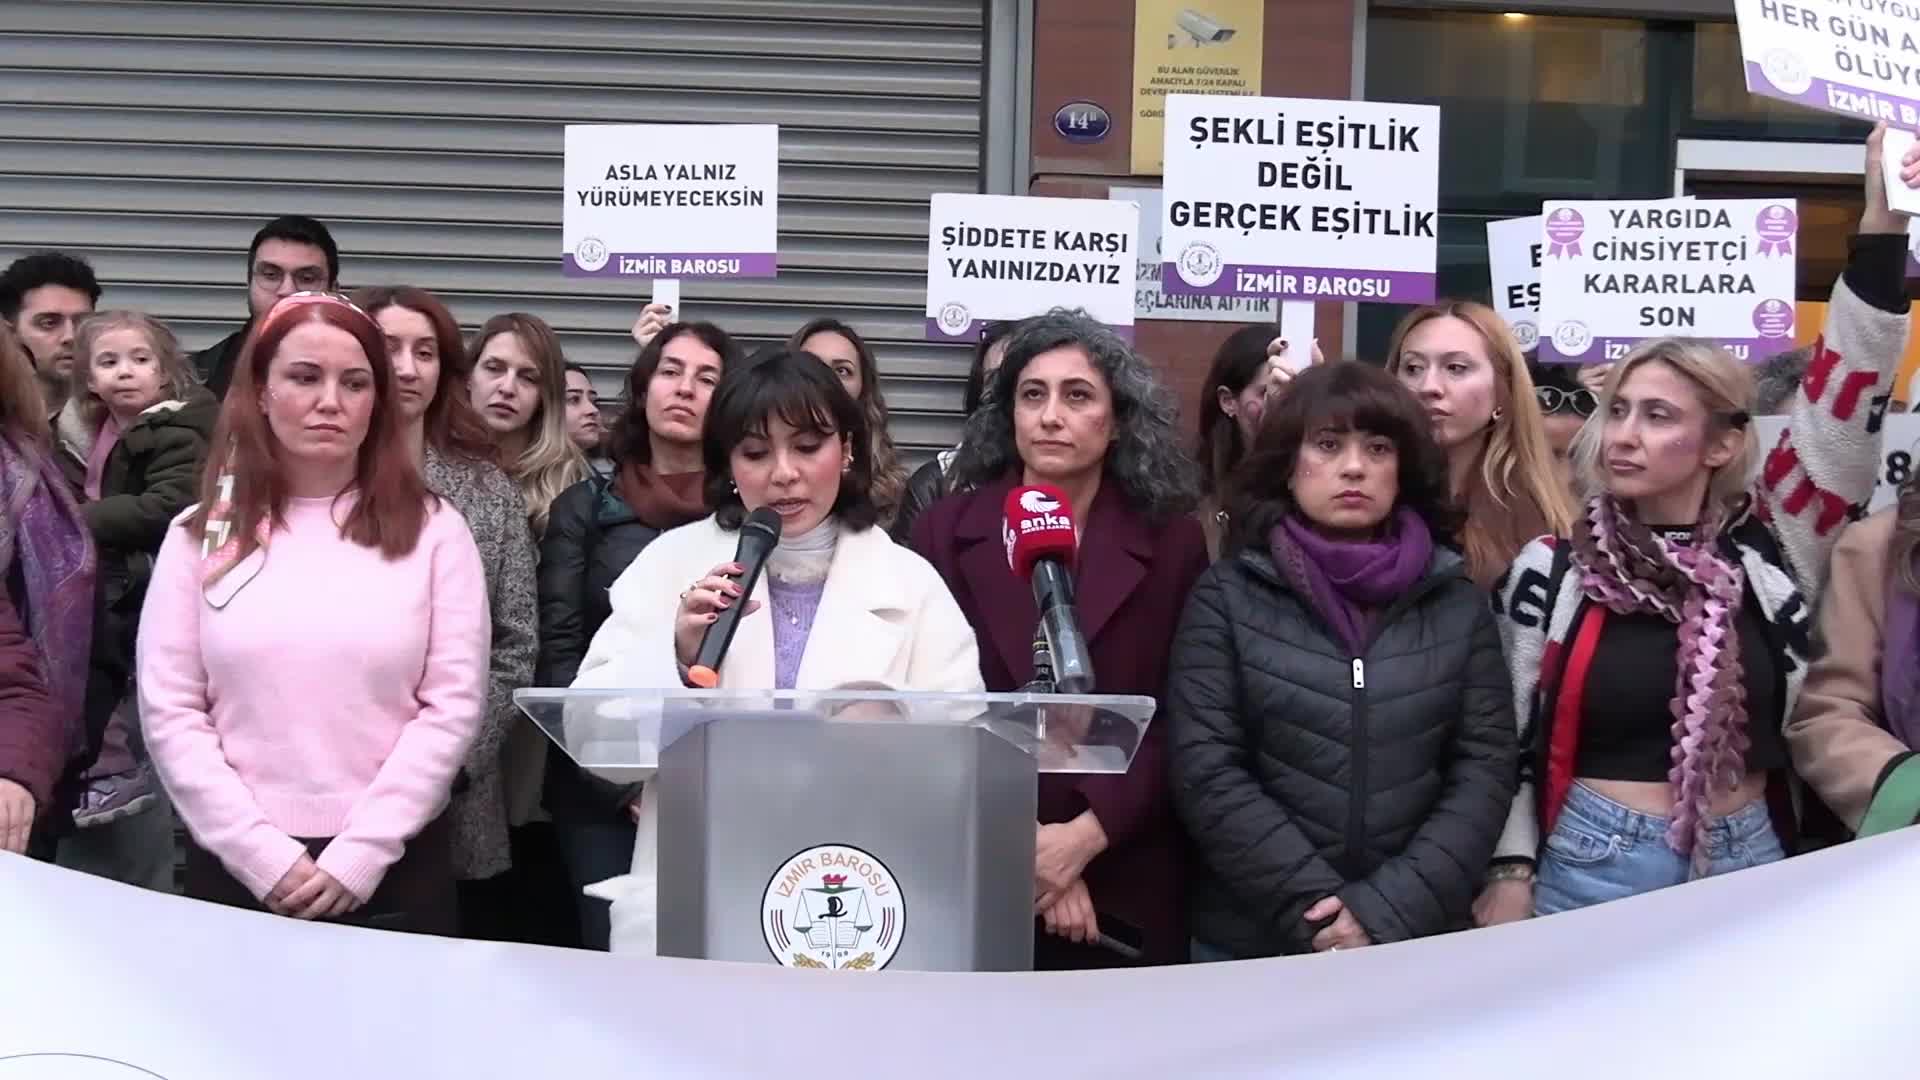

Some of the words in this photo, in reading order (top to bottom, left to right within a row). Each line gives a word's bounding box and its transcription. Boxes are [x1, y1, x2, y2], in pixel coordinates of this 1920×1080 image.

[1760, 0, 1820, 32] HER
[1828, 14, 1890, 48] GÜN
[1826, 83, 1897, 121] İZMİR
[1190, 113, 1285, 149] ŞEKLİ
[1296, 117, 1420, 154] EŞİTLİK
[605, 164, 658, 181] ASLA
[664, 164, 736, 181] YALNIZ
[1258, 156, 1353, 191] DEĞİL
[577, 186, 763, 207] YÜRÜMEYECEKSİN
[1169, 201, 1302, 236] GERÇEK
[1311, 201, 1434, 240] EŞİTLİK
[1609, 208, 1732, 229] YARGIDA
[941, 221, 1047, 251] ŞİDDETE
[1054, 230, 1128, 258] KARŞI
[1592, 236, 1747, 266] CİNSİYETÇİ
[619, 255, 667, 274] İZMİR
[671, 258, 740, 274] BAROSU
[947, 257, 1121, 285] YANINIZDAYIZ
[1236, 268, 1297, 294] İZMİR
[1303, 275, 1391, 297] BAROSU
[1584, 273, 1756, 294] KARARLARA
[1639, 306, 1695, 327] SON
[1021, 512, 1070, 529] anka
[820, 852, 889, 897] BAROSU
